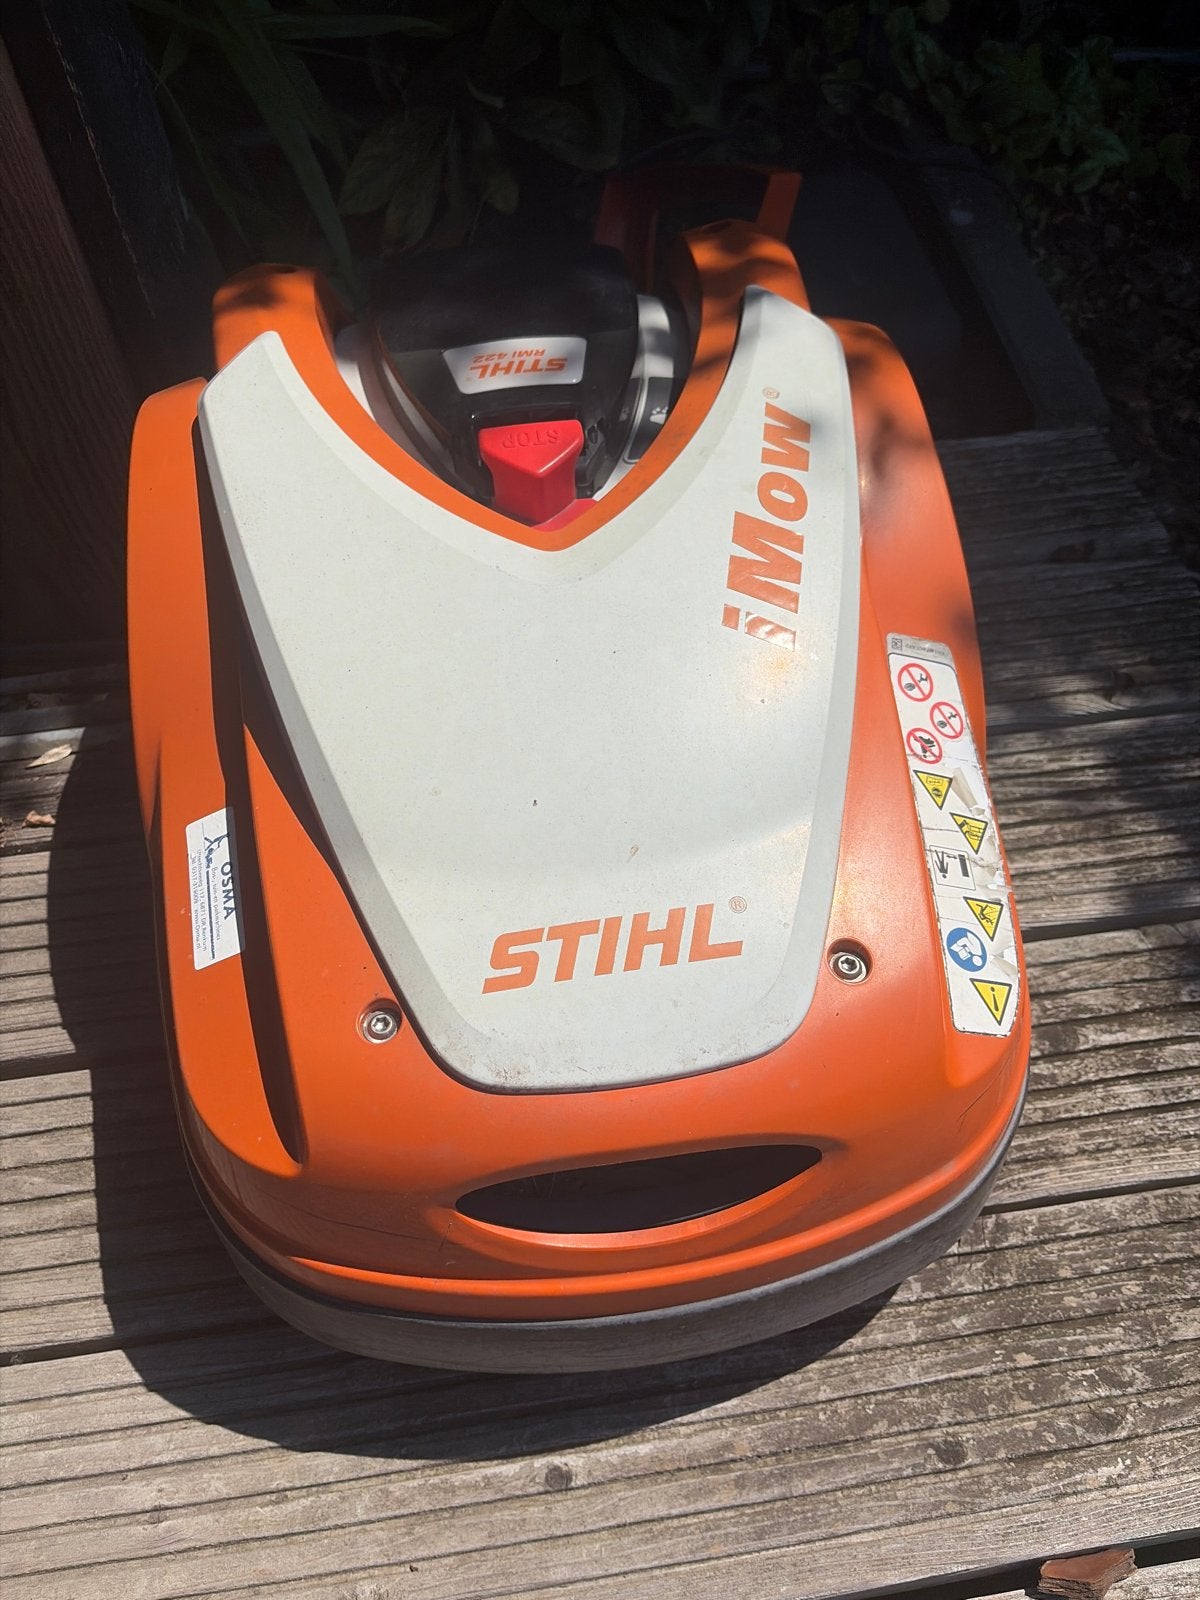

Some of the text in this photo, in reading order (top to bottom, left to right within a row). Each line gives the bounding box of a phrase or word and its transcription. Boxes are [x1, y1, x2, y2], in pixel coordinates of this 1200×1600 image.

[472, 349, 546, 364] RMI 422
[469, 357, 568, 380] STIHL
[502, 428, 559, 449] STOP
[220, 861, 237, 920] OSMA
